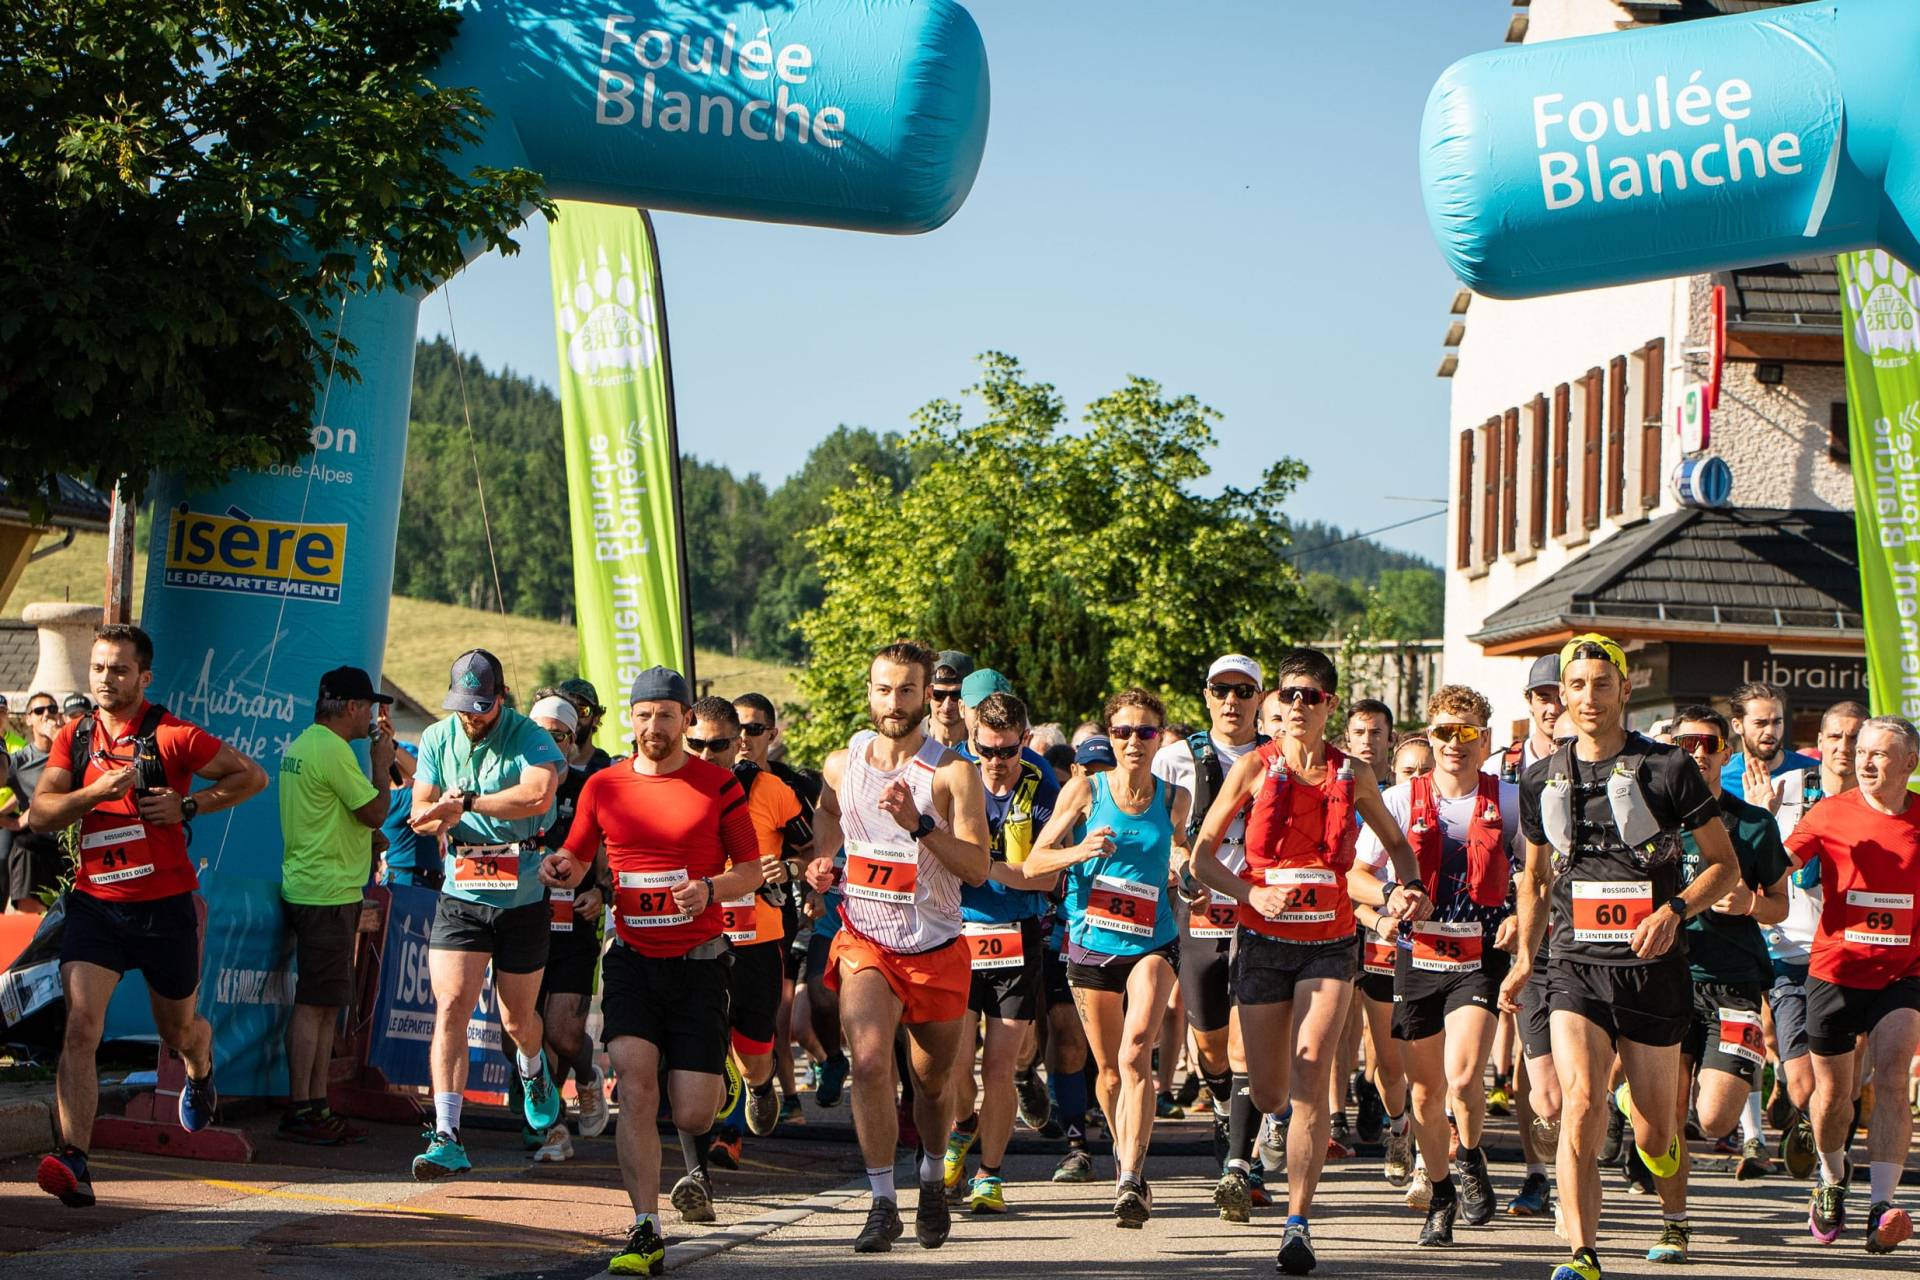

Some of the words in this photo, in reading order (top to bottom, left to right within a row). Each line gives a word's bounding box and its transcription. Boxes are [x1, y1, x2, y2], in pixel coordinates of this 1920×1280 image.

[601, 14, 812, 84] Foulée
[596, 70, 845, 150] Blanche
[1533, 70, 1752, 148] Foulée
[1539, 124, 1803, 210] Blanche
[173, 502, 334, 576] isère
[166, 571, 183, 584] LE
[186, 571, 338, 598] DÉPARTEMENT
[188, 648, 294, 726] Autrans
[102, 847, 128, 868] 41
[873, 848, 906, 858] ROSSIGNOL
[121, 870, 133, 878] DES
[133, 866, 152, 876] OURS
[474, 860, 498, 876] 30
[867, 863, 893, 885] 77
[643, 875, 677, 884] ROSSIGNOL
[855, 887, 879, 897] SENTIER
[880, 892, 894, 900] DES
[893, 893, 911, 902] OURS
[1288, 888, 1318, 907] 24
[1602, 886, 1639, 894] ROSSIGNOL
[639, 892, 667, 913] 87
[1108, 897, 1136, 918] 83
[631, 917, 658, 925] SENTIER
[1210, 907, 1235, 925] 52
[1318, 912, 1334, 920] OURS
[1595, 904, 1627, 926] 60
[1866, 911, 1894, 930] 69
[1134, 925, 1151, 935] OURS
[978, 938, 1002, 956] 20
[1434, 939, 1461, 958] 85
[1462, 962, 1480, 970] OURS
[388, 1020, 398, 1033] LE
[1743, 1026, 1763, 1049] 68
